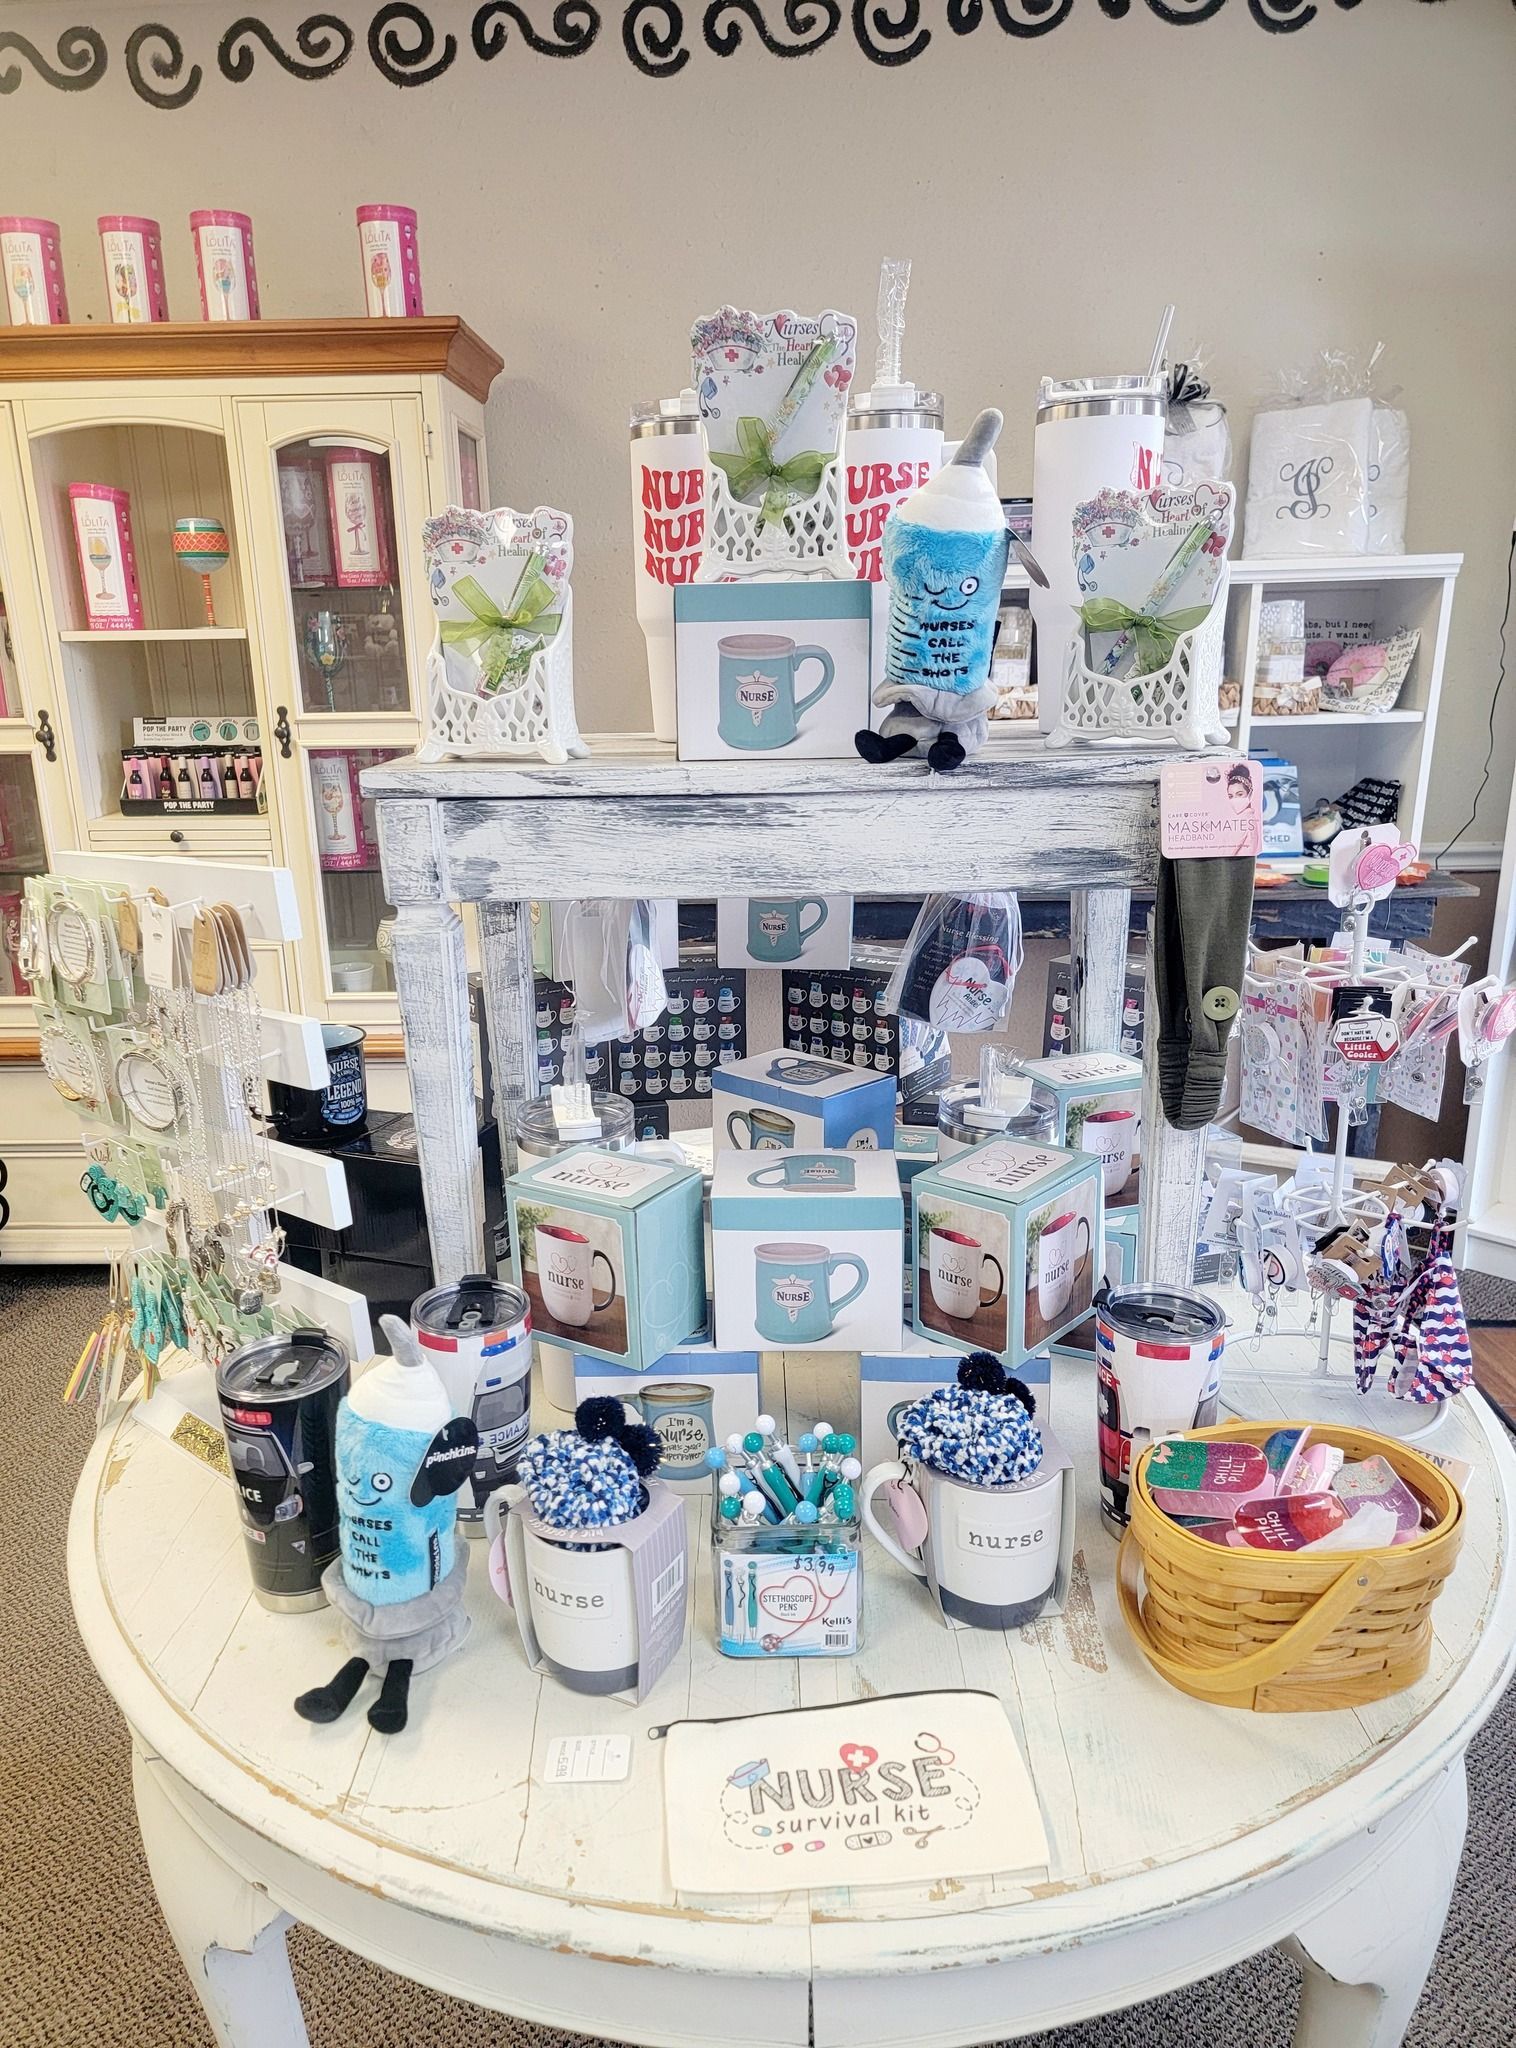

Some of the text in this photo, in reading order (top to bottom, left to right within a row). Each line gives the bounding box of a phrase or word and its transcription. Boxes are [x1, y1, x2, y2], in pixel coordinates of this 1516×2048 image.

[764, 314, 819, 340] Nurses
[777, 352, 810, 367] Heali
[640, 464, 704, 514] NUR
[847, 461, 930, 506] URSE
[1141, 489, 1194, 513] Nurses
[1161, 509, 1190, 524] Heart
[643, 510, 704, 555] NUR
[920, 619, 976, 632] NURSES
[1325, 620, 1342, 629] but
[1344, 620, 1348, 628] I
[928, 636, 965, 649] CALL
[931, 652, 961, 664] THE
[922, 666, 970, 678] SHOTS
[740, 690, 774, 702] NURSE
[164, 801, 214, 809] POP THE PARTY
[1168, 833, 1215, 842] HEADBAND
[1264, 834, 1301, 843] CHED
[762, 922, 786, 931] NURSE
[940, 924, 1000, 944] Nurse Blessing
[965, 977, 992, 1007] Nurse
[963, 993, 980, 1009] Angel
[1344, 1043, 1372, 1051] Little
[1347, 1051, 1378, 1059] Cooler
[328, 1056, 361, 1075] NURSE
[1062, 1063, 1133, 1081] nurse
[327, 1078, 362, 1101] LEGEND
[340, 1098, 356, 1109] 100%
[766, 1140, 776, 1149] I'm
[856, 1139, 865, 1149] I'm
[995, 1153, 1056, 1186] nurse
[551, 1170, 631, 1191] nurse
[937, 1267, 973, 1288] nurse
[1044, 1257, 1070, 1284] nurse
[547, 1269, 584, 1291] nurse
[776, 1291, 811, 1302] NURSE
[666, 1417, 694, 1428] I'm a
[658, 1428, 706, 1443] Nurse.
[666, 1450, 706, 1462] perpower?
[1213, 1455, 1232, 1485] CHILL
[1227, 1461, 1246, 1483] PILL
[240, 1486, 263, 1503] LICE
[351, 1516, 394, 1532] URSES
[1254, 1517, 1276, 1544] PILL
[1266, 1511, 1295, 1547] CHILL
[351, 1531, 382, 1548] CALL
[968, 1529, 1044, 1550] nurse
[354, 1547, 379, 1563] THE
[793, 1554, 836, 1577] $3.99
[533, 1577, 605, 1609] nurse
[763, 1594, 814, 1603] STETHOSCOPE
[779, 1603, 798, 1612] PENS
[821, 1616, 853, 1628] Kelli's
[747, 1756, 953, 1815] NURSE
[775, 1804, 932, 1836] survival kit
